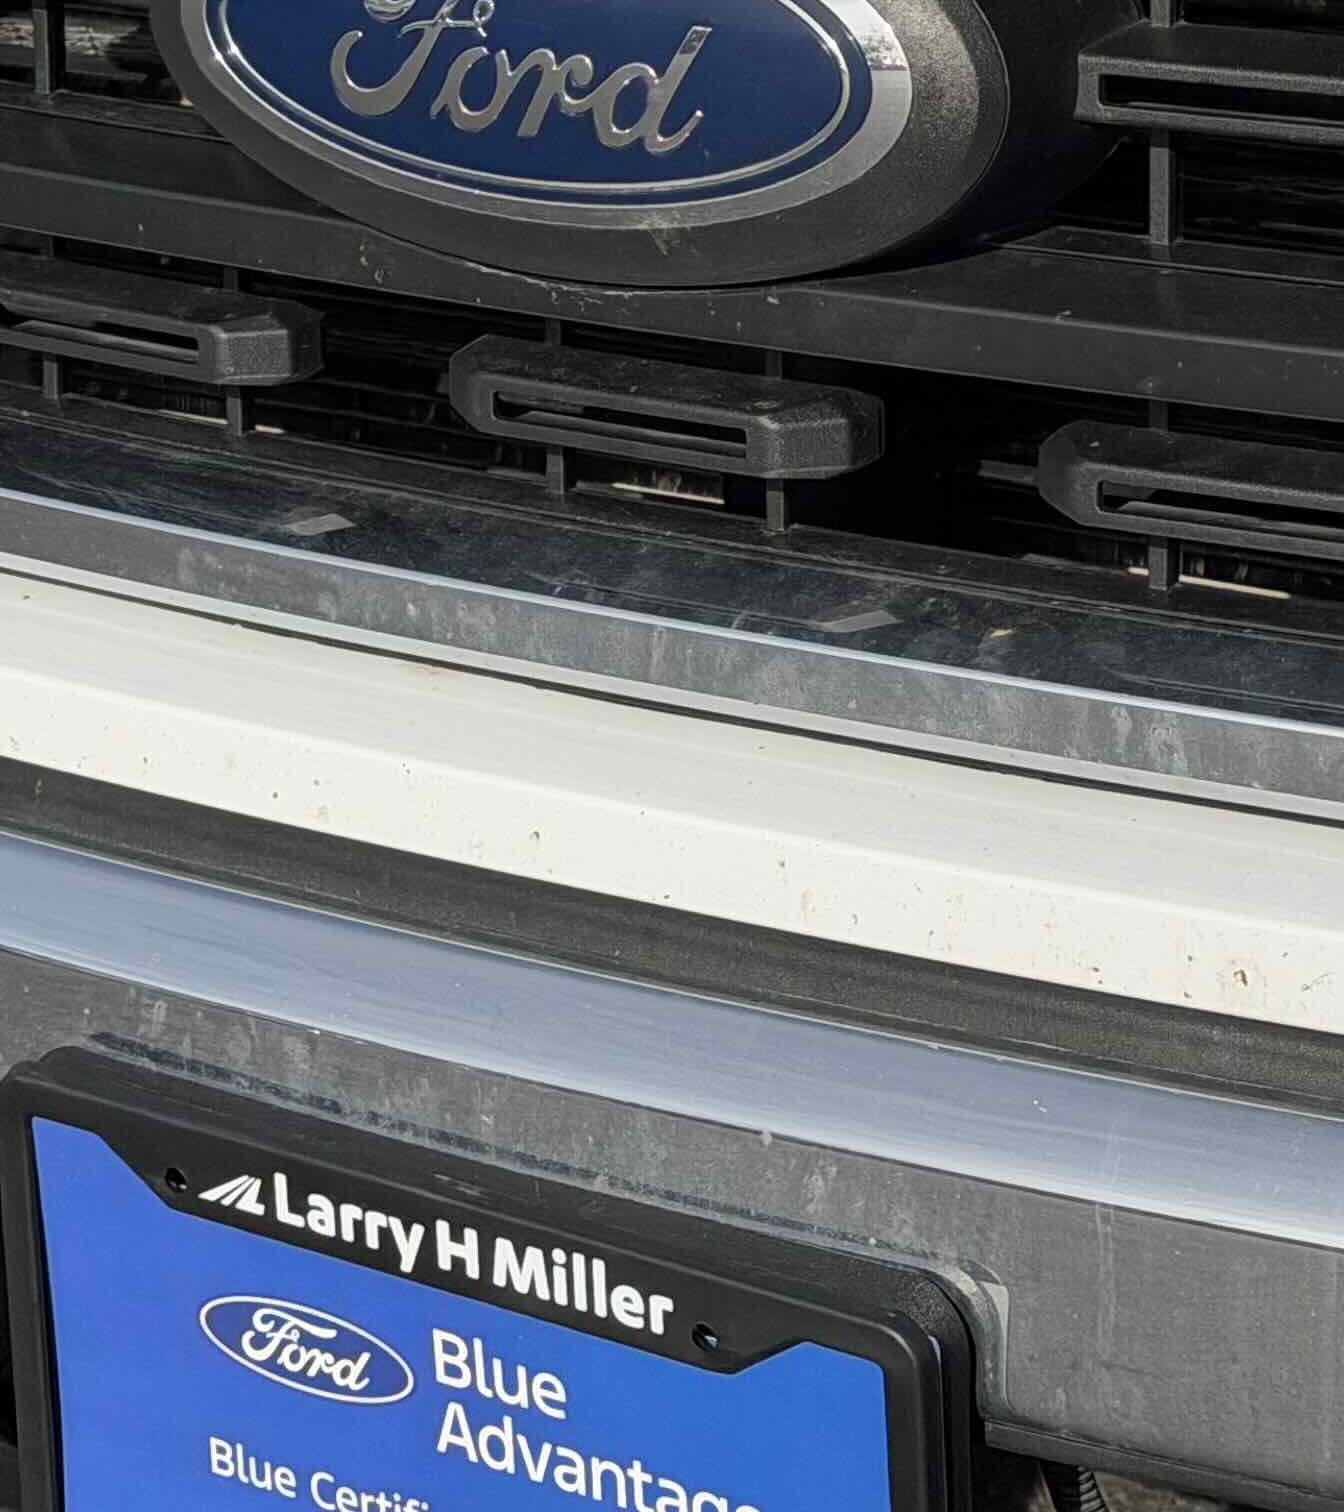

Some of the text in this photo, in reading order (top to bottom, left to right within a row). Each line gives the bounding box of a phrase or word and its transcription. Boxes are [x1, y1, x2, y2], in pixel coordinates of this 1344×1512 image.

[272, 1171, 675, 1336] Larry H Miller
[240, 1307, 372, 1391] Ford
[431, 1327, 568, 1420] Blue
[208, 1436, 297, 1499] Blue
[435, 1401, 762, 1512] Advanta
